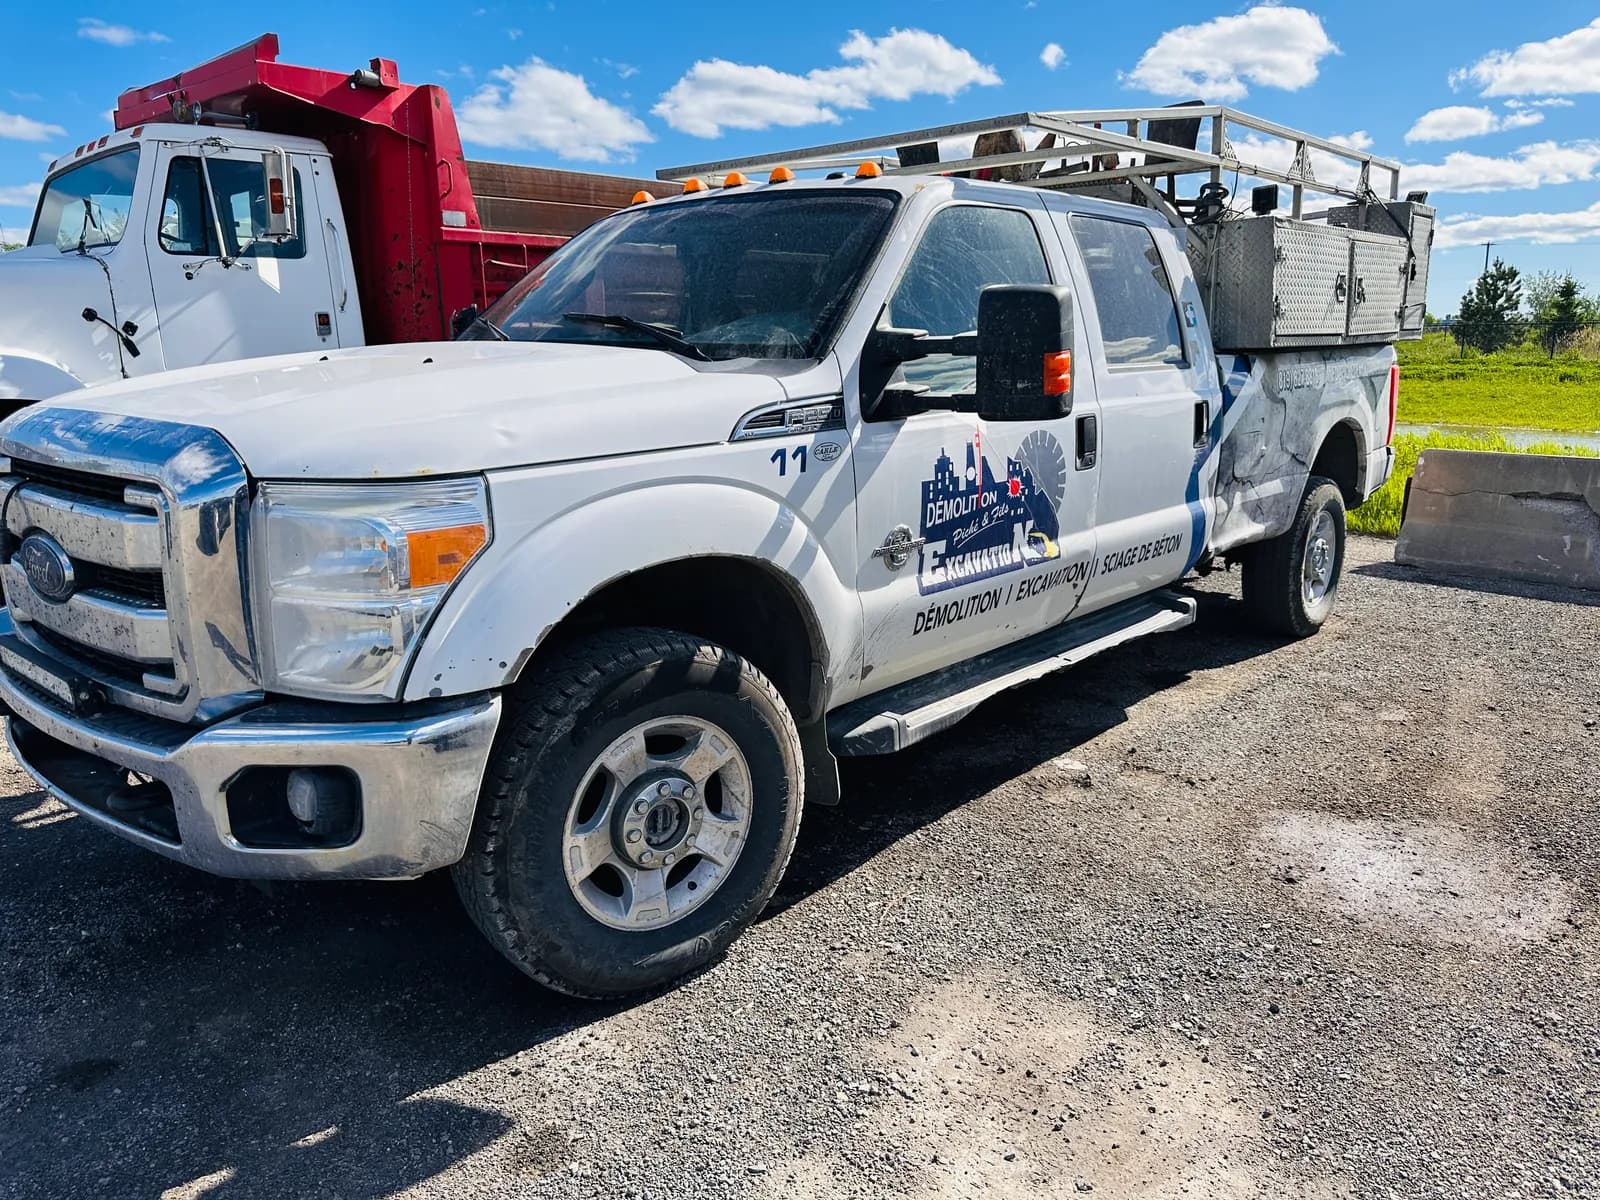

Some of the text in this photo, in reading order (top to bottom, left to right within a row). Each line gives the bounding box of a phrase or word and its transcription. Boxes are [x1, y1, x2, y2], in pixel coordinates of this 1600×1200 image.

[770, 445, 808, 477] 11
[952, 502, 1010, 546] Piché & Fils
[912, 587, 1003, 636] DÉMOLITION
[1016, 561, 1088, 601] EXCAVATION
[1101, 546, 1137, 575] SCIAGE
[1137, 543, 1151, 562] DE
[1151, 533, 1183, 558] BÉTON
